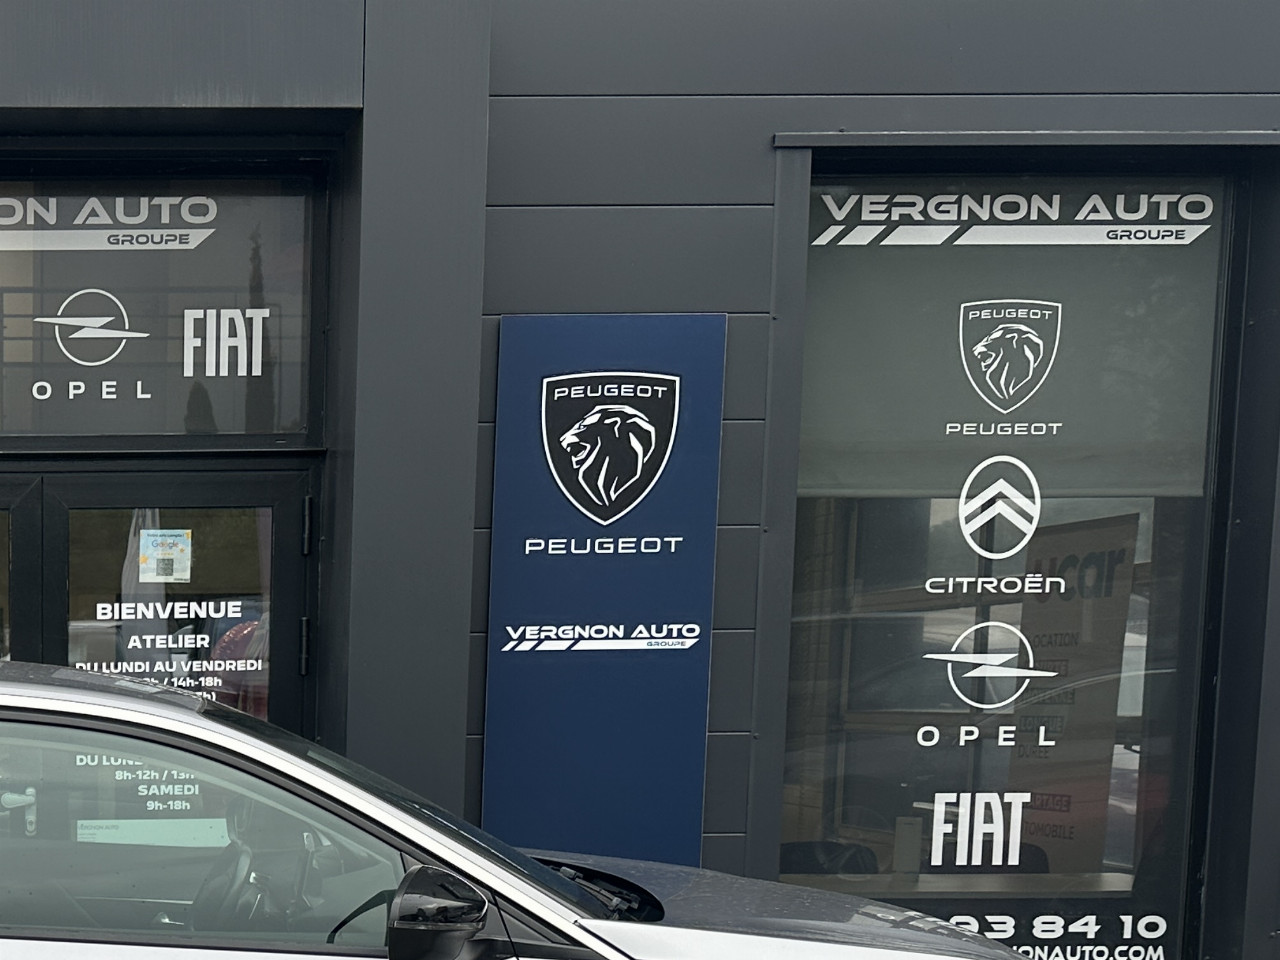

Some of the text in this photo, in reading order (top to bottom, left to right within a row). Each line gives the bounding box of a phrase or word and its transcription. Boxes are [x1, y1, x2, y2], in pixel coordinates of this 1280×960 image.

[73, 197, 217, 224] AUTO
[822, 195, 1213, 220] VERGNON AUTO
[108, 234, 189, 245] GROUPE
[1107, 230, 1185, 240] GROUPE
[969, 309, 1052, 319] PEUGEOT
[184, 309, 269, 377] FIAT
[555, 385, 667, 400] PEUGEOT
[946, 423, 1062, 434] PEUGEOT
[151, 539, 179, 550] Google
[526, 538, 683, 554] PEUGEOT
[97, 601, 241, 619] BIENVENUE
[505, 624, 700, 640] VERGNON AUTO
[128, 635, 209, 648] ATELIER
[1031, 632, 1080, 649] OCATION
[102, 661, 150, 674] LUNDI
[153, 660, 177, 672] AU
[180, 659, 262, 672] VENDREDI
[170, 676, 223, 687] 14h-18h
[76, 755, 98, 765] DU
[115, 770, 159, 780] 8h-12h
[138, 785, 198, 795] SAMEDI
[147, 801, 190, 810] 9h-18h
[930, 792, 1031, 866] FIAT
[1033, 916, 1101, 938] 84
[1120, 916, 1166, 938] 10
